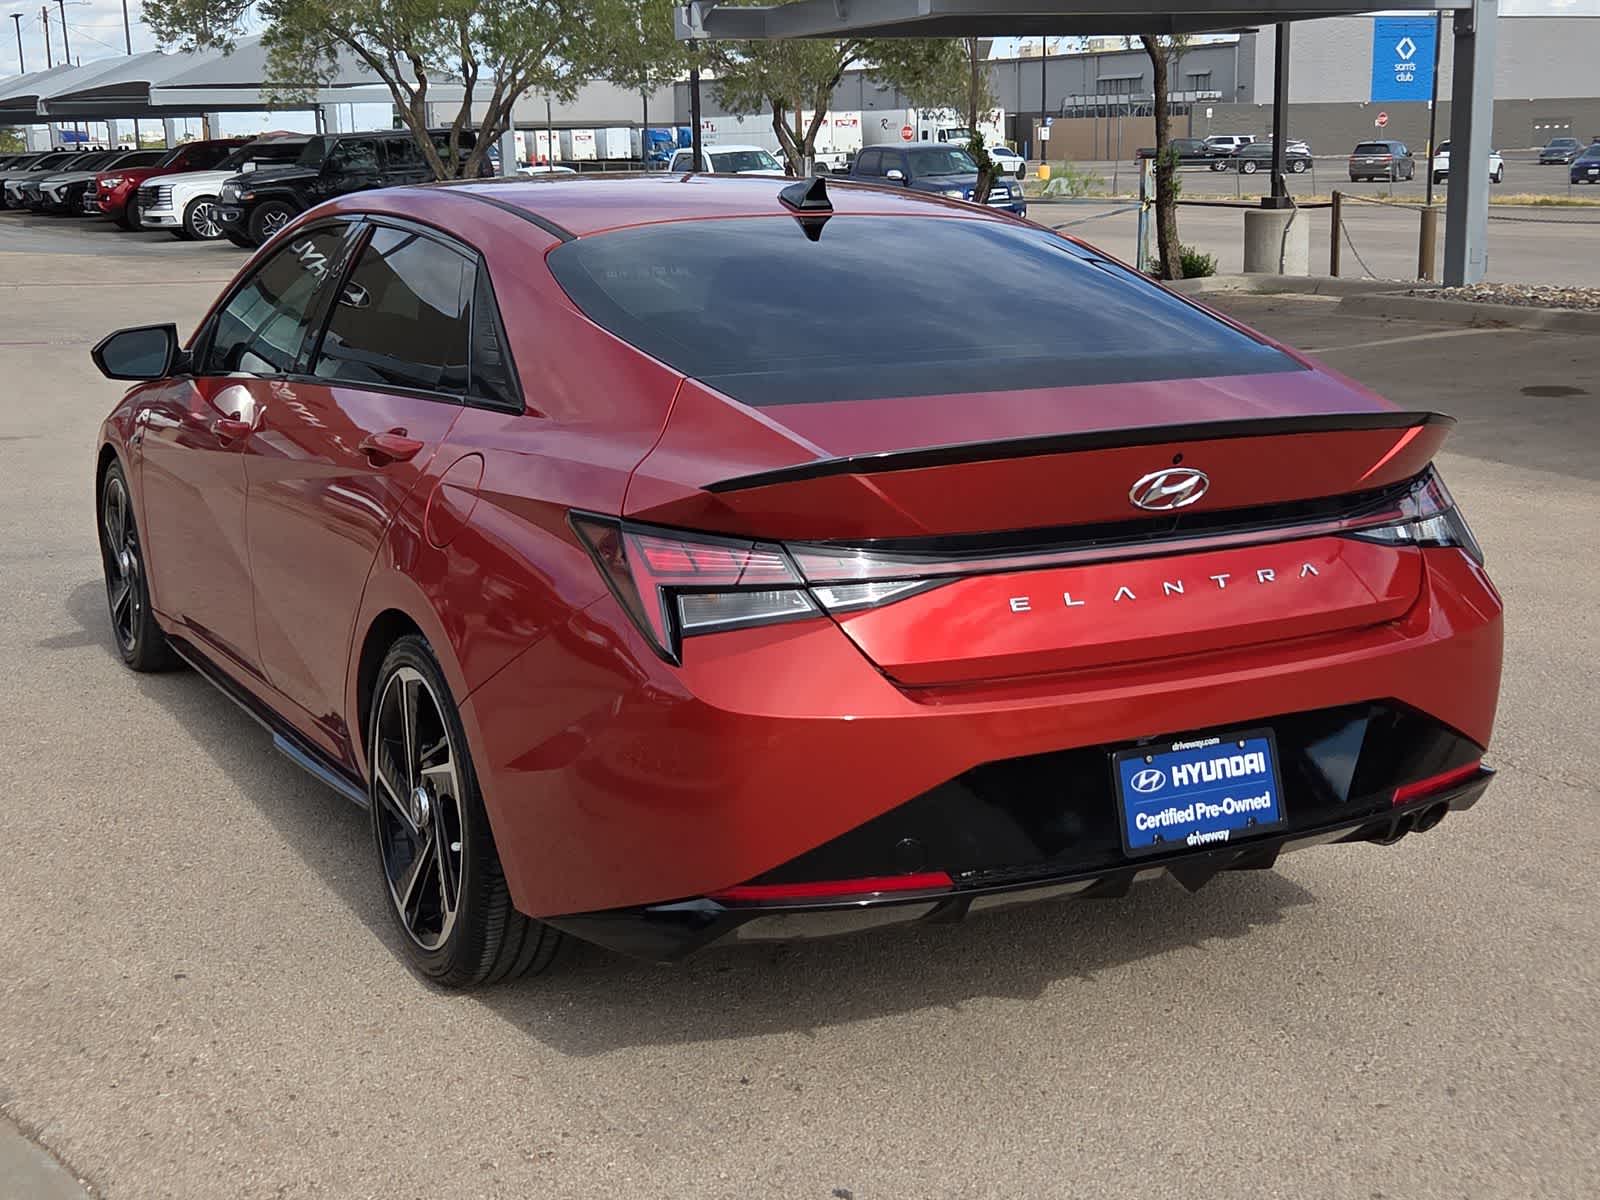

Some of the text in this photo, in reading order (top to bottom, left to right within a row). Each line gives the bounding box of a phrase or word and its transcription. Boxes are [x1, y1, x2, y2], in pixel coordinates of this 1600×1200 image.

[1396, 72, 1414, 82] club
[1009, 562, 1320, 613] ELANTRA
[1172, 736, 1221, 752] driveway.com
[1171, 752, 1266, 787] HYUNDAI
[1135, 791, 1271, 831] Certified Pre-Owned
[1186, 829, 1231, 847] driveway
